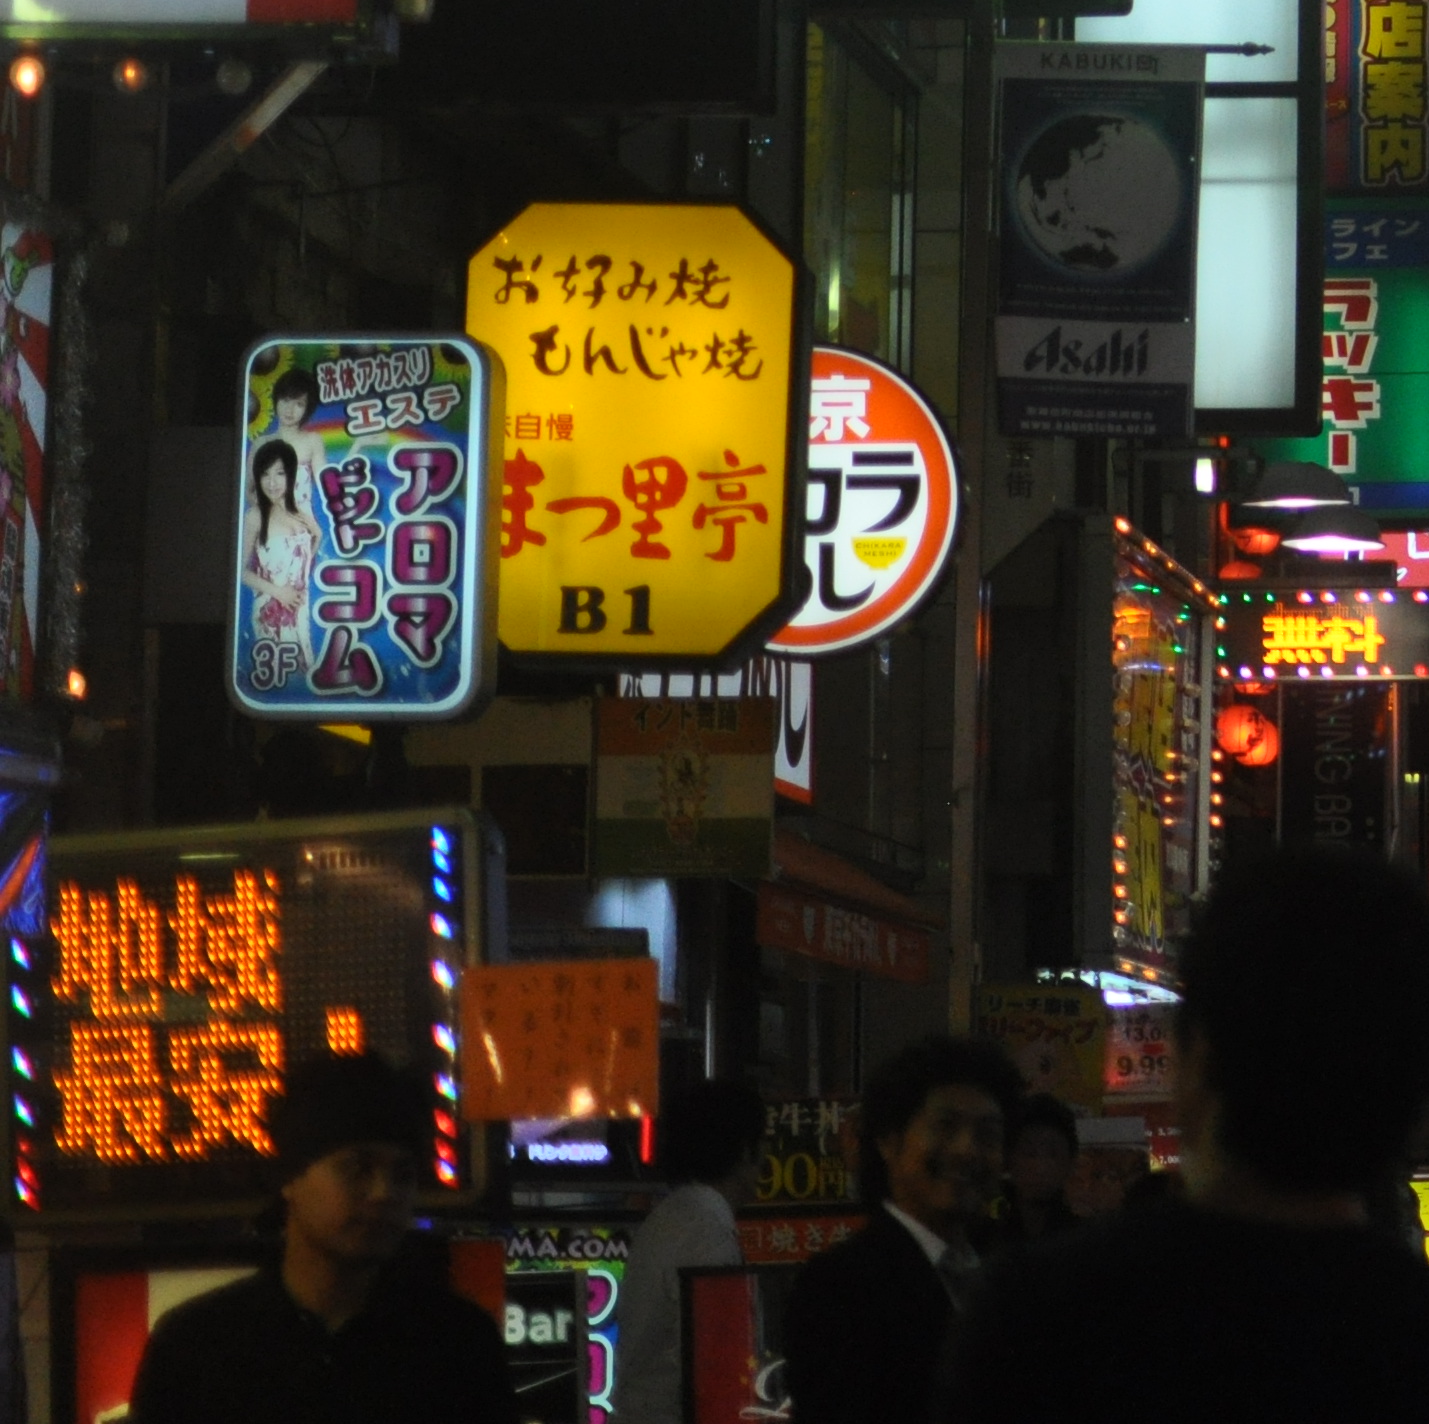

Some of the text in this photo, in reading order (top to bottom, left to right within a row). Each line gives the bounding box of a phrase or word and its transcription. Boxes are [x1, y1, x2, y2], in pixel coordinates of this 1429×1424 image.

[492, 254, 732, 310] お好み焼
[529, 324, 765, 382] もんじゃ焼
[1023, 325, 1151, 377] Asahi
[347, 383, 461, 436] エステ
[309, 457, 386, 695] ドットコム
[383, 443, 463, 667] アロマ
[557, 584, 655, 636] B1
[251, 639, 300, 690] 3F
[1262, 616, 1385, 664] 無料
[504, 1304, 574, 1345] Bar
